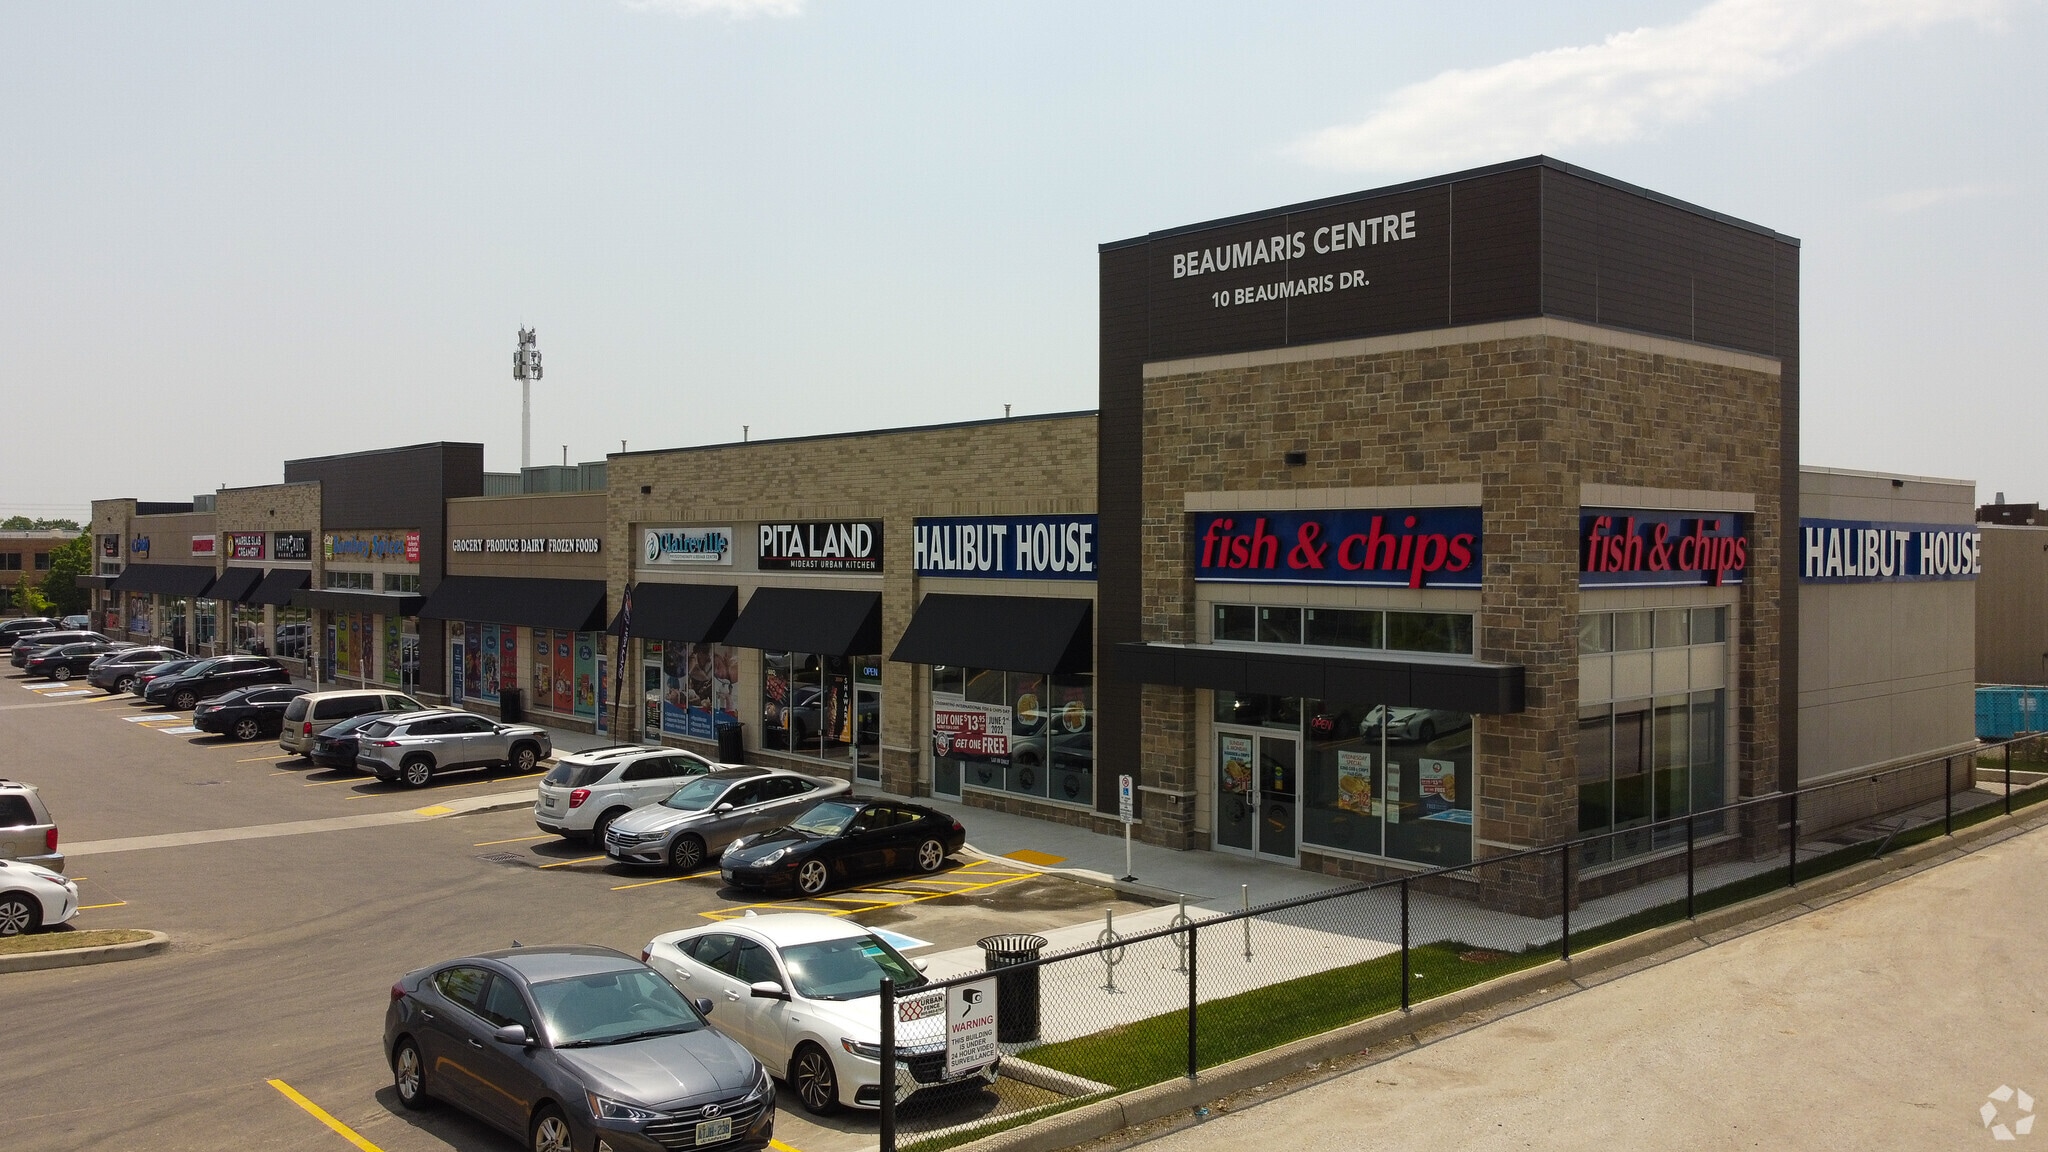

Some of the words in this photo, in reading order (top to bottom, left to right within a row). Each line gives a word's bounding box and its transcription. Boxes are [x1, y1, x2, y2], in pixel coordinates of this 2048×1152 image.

[1173, 230, 1306, 279] BEAUMARIS
[1313, 210, 1416, 254] CENTRE
[1211, 290, 1230, 308] 10
[1234, 274, 1334, 305] BEAUMARIS
[1339, 269, 1370, 290] DR.
[250, 535, 262, 546] SLAB
[333, 535, 370, 558] Bombay
[372, 535, 405, 558] Spices
[452, 539, 483, 552] GROCERY
[486, 539, 519, 552] PRODUCE
[521, 538, 546, 553] DAIRY
[548, 538, 574, 553] FROZEN
[575, 538, 599, 553] FOODS
[660, 532, 727, 553] Claireville
[760, 524, 806, 558] PITA
[809, 523, 873, 558] LAND
[913, 524, 1007, 572] HALIBUT
[1016, 522, 1093, 572] HOUSE
[238, 547, 260, 557] CREAMERY
[1200, 517, 1279, 570] fish
[1286, 520, 1329, 570] &
[1337, 515, 1475, 589] chips
[1587, 515, 1644, 573] fish
[1648, 522, 1674, 572] &
[1678, 517, 1747, 587] chips
[1805, 527, 1910, 577] HALIBUT
[1920, 531, 1981, 575] HOUSE
[790, 560, 818, 568] MIDEAST
[820, 560, 843, 569] URBAN
[845, 561, 876, 569] KITCHEN
[863, 667, 878, 676] OPEN
[936, 713, 949, 725] BUY
[949, 714, 964, 726] ONE
[988, 716, 1001, 725] JUNE
[1312, 718, 1333, 731] OPEN
[991, 725, 1004, 734] 2023
[955, 738, 968, 749] GET
[968, 739, 981, 750] ONE
[982, 736, 1005, 754] FREE
[1341, 753, 1368, 761] WEDNESDAY
[920, 995, 943, 1006] URBAN
[923, 1003, 940, 1011] FENCE
[952, 1014, 994, 1034] WARNING
[951, 1036, 965, 1046] THIS
[965, 1029, 993, 1042] BUILDING
[959, 1042, 966, 1051] IS
[966, 1037, 987, 1049] UNDER
[951, 1049, 995, 1067] SURVEILLANCE
[958, 1047, 976, 1058] HOUR
[976, 1042, 995, 1053] VIDEO
